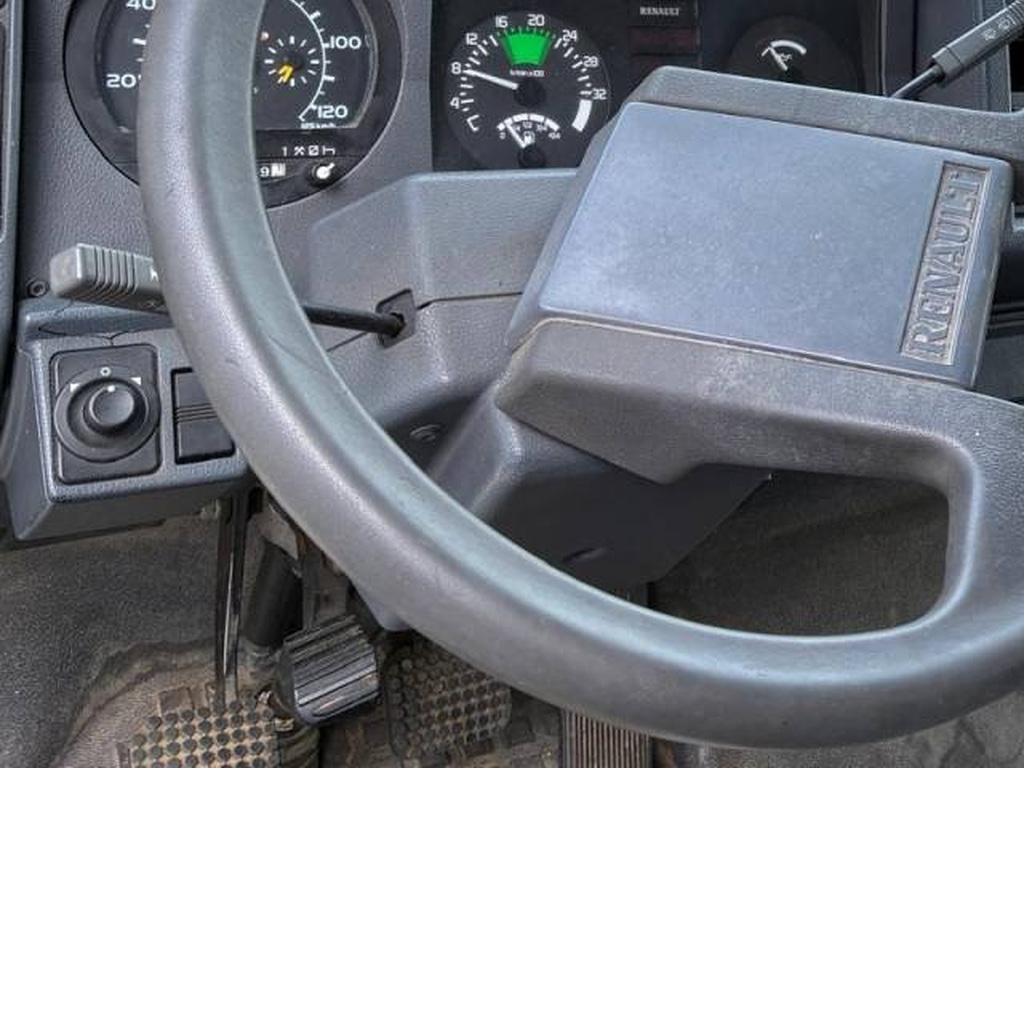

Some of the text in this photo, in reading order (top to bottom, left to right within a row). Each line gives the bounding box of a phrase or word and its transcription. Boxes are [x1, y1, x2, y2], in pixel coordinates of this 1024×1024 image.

[495, 15, 508, 28] 16
[528, 14, 545, 26] 20
[466, 33, 478, 45] 12
[562, 29, 578, 42] 24
[330, 37, 361, 50] 100
[583, 55, 599, 67] 28
[451, 62, 461, 74] 8
[106, 75, 136, 88] 20
[592, 88, 607, 100] 32
[449, 97, 460, 109] 4
[317, 105, 348, 119] 120
[907, 169, 981, 358] RENAULT
